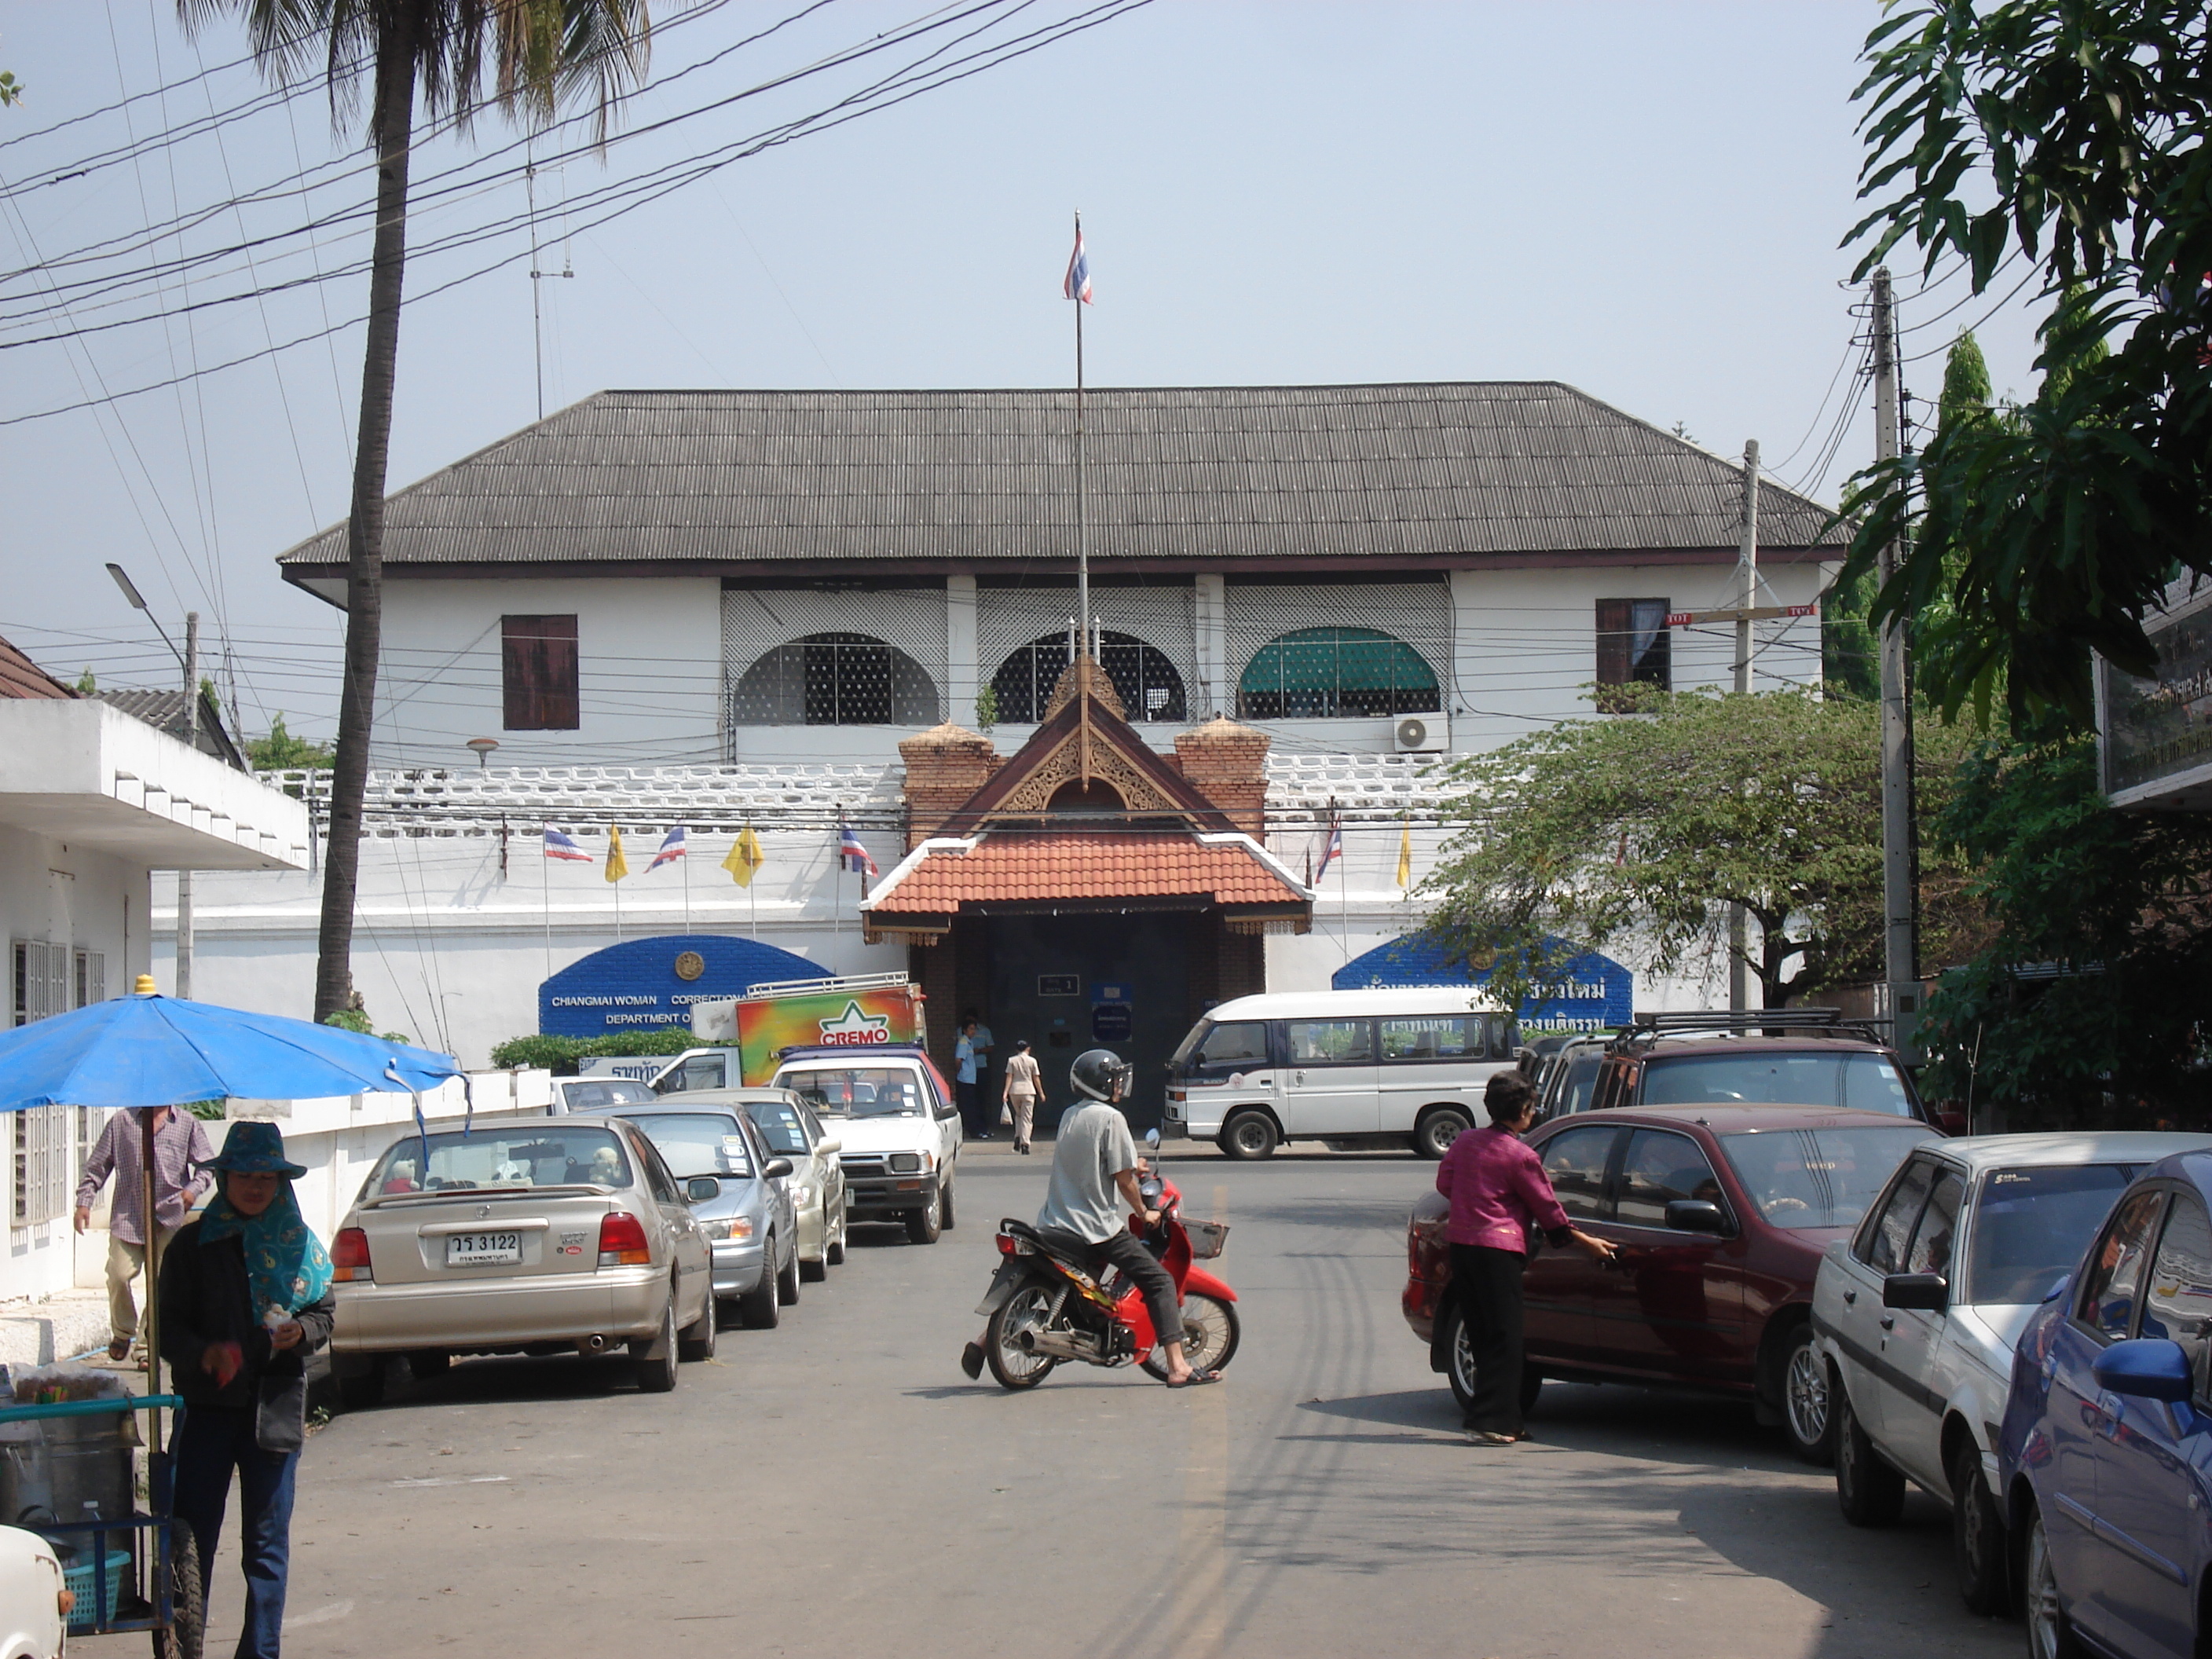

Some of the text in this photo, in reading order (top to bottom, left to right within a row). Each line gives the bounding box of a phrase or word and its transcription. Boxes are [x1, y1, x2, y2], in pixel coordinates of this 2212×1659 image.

[1667, 613, 1688, 623] TOT
[551, 995, 613, 1007] CHIANGMAI
[614, 994, 657, 1006] WOMAN
[606, 1013, 679, 1024] DEPARTMENT
[822, 1028, 888, 1046] CREMO
[452, 1234, 516, 1252] วร 3122
